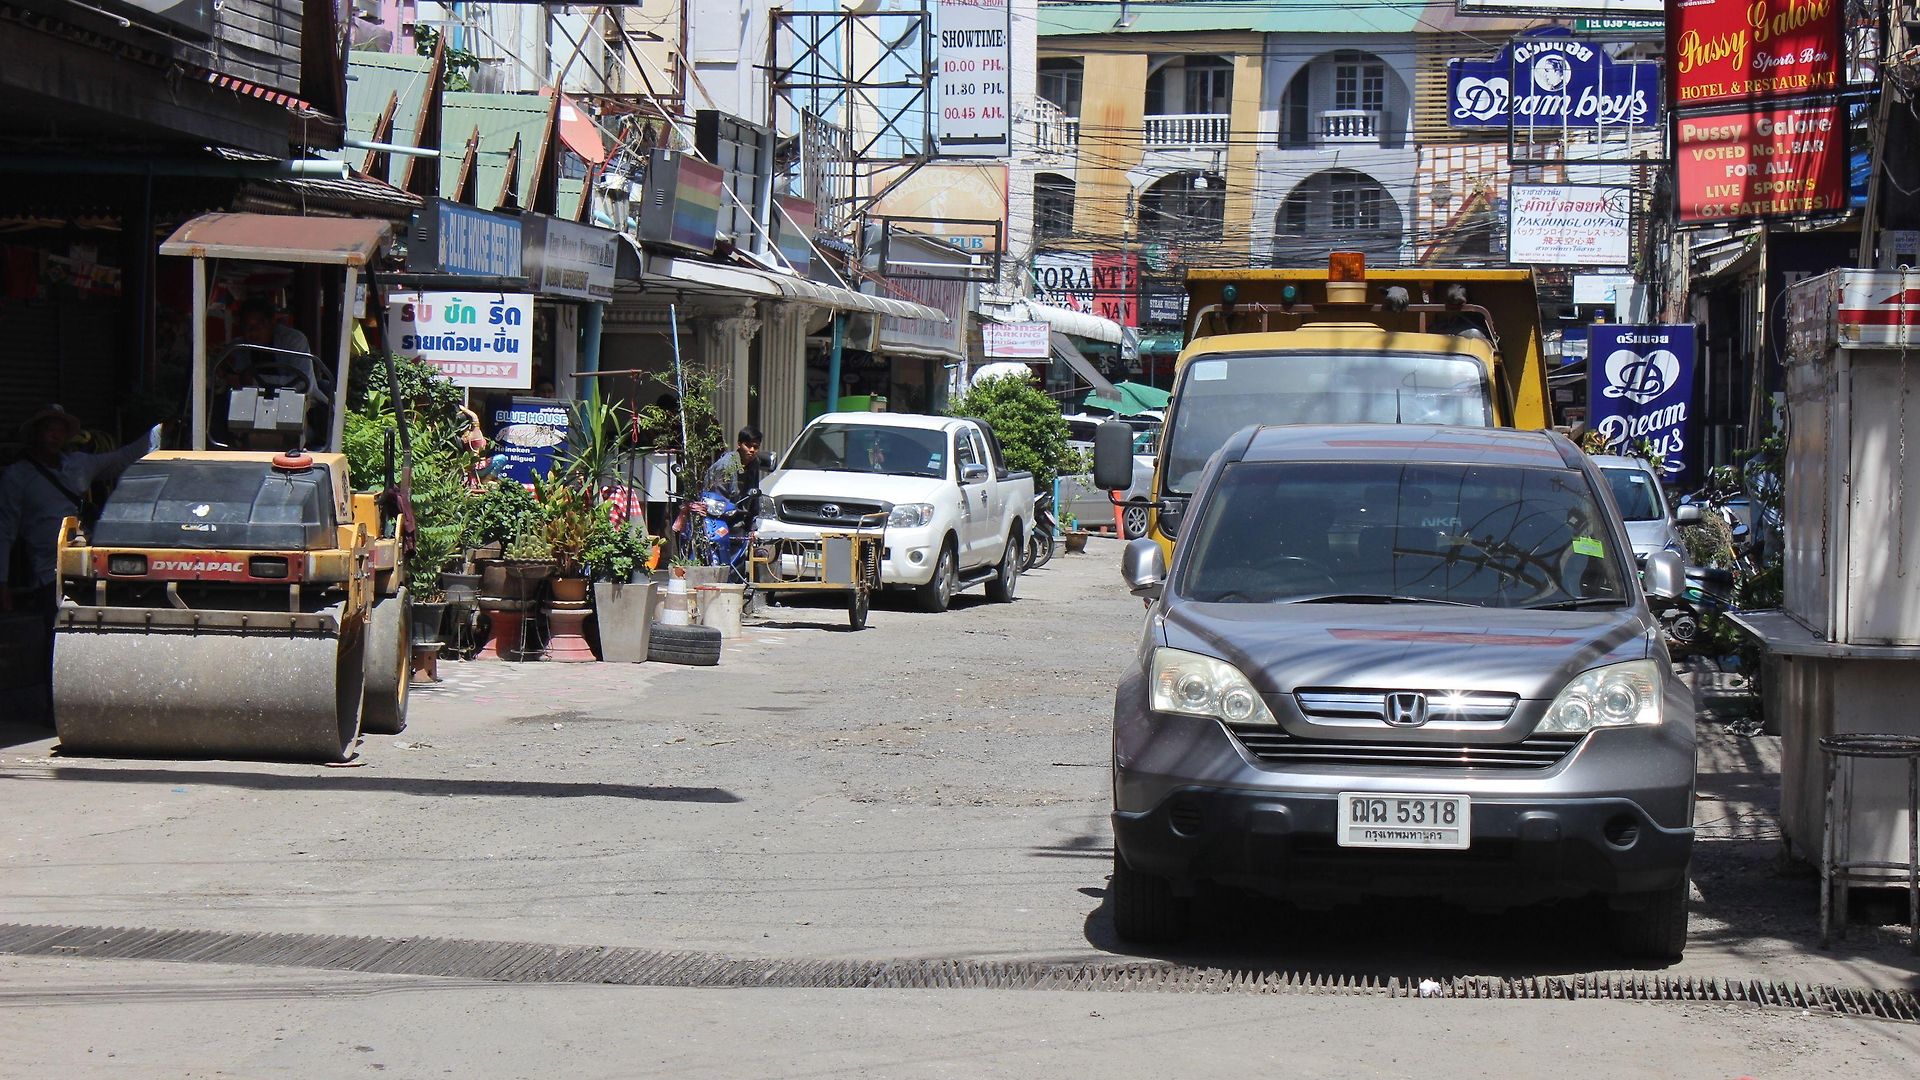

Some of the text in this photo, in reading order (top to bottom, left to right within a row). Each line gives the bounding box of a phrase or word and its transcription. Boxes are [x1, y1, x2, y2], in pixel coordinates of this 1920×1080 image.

[1747, 0, 1831, 42] Galore
[942, 30, 1006, 48] SHOWTIME:
[1678, 28, 1749, 73] Pussy
[1753, 47, 1829, 72] Sports Bar
[944, 60, 975, 72] 10.00
[945, 83, 975, 95] 11.30
[1681, 72, 1835, 99] HOTEL & RESTAURANT
[944, 107, 975, 119] 00.45
[1454, 84, 1648, 124] Dream boys
[1682, 114, 1831, 143] Pussy Galore
[1692, 145, 1745, 161] VOTED
[1726, 160, 1793, 178] FOR ALL
[1706, 178, 1816, 198] LIVE SPORTS
[449, 212, 467, 270] BLUE
[468, 215, 489, 272] HOUSE
[491, 221, 508, 276] BEER
[949, 237, 984, 249] PUB
[987, 331, 1041, 339] PARKING
[434, 362, 513, 376] UNDRY
[495, 411, 528, 424] BLUE
[528, 412, 569, 426] HOUSE
[1598, 401, 1688, 450] Dream
[510, 455, 536, 463] Miguel
[151, 561, 244, 573] DYNAPAC
[1397, 801, 1456, 824] 5318
